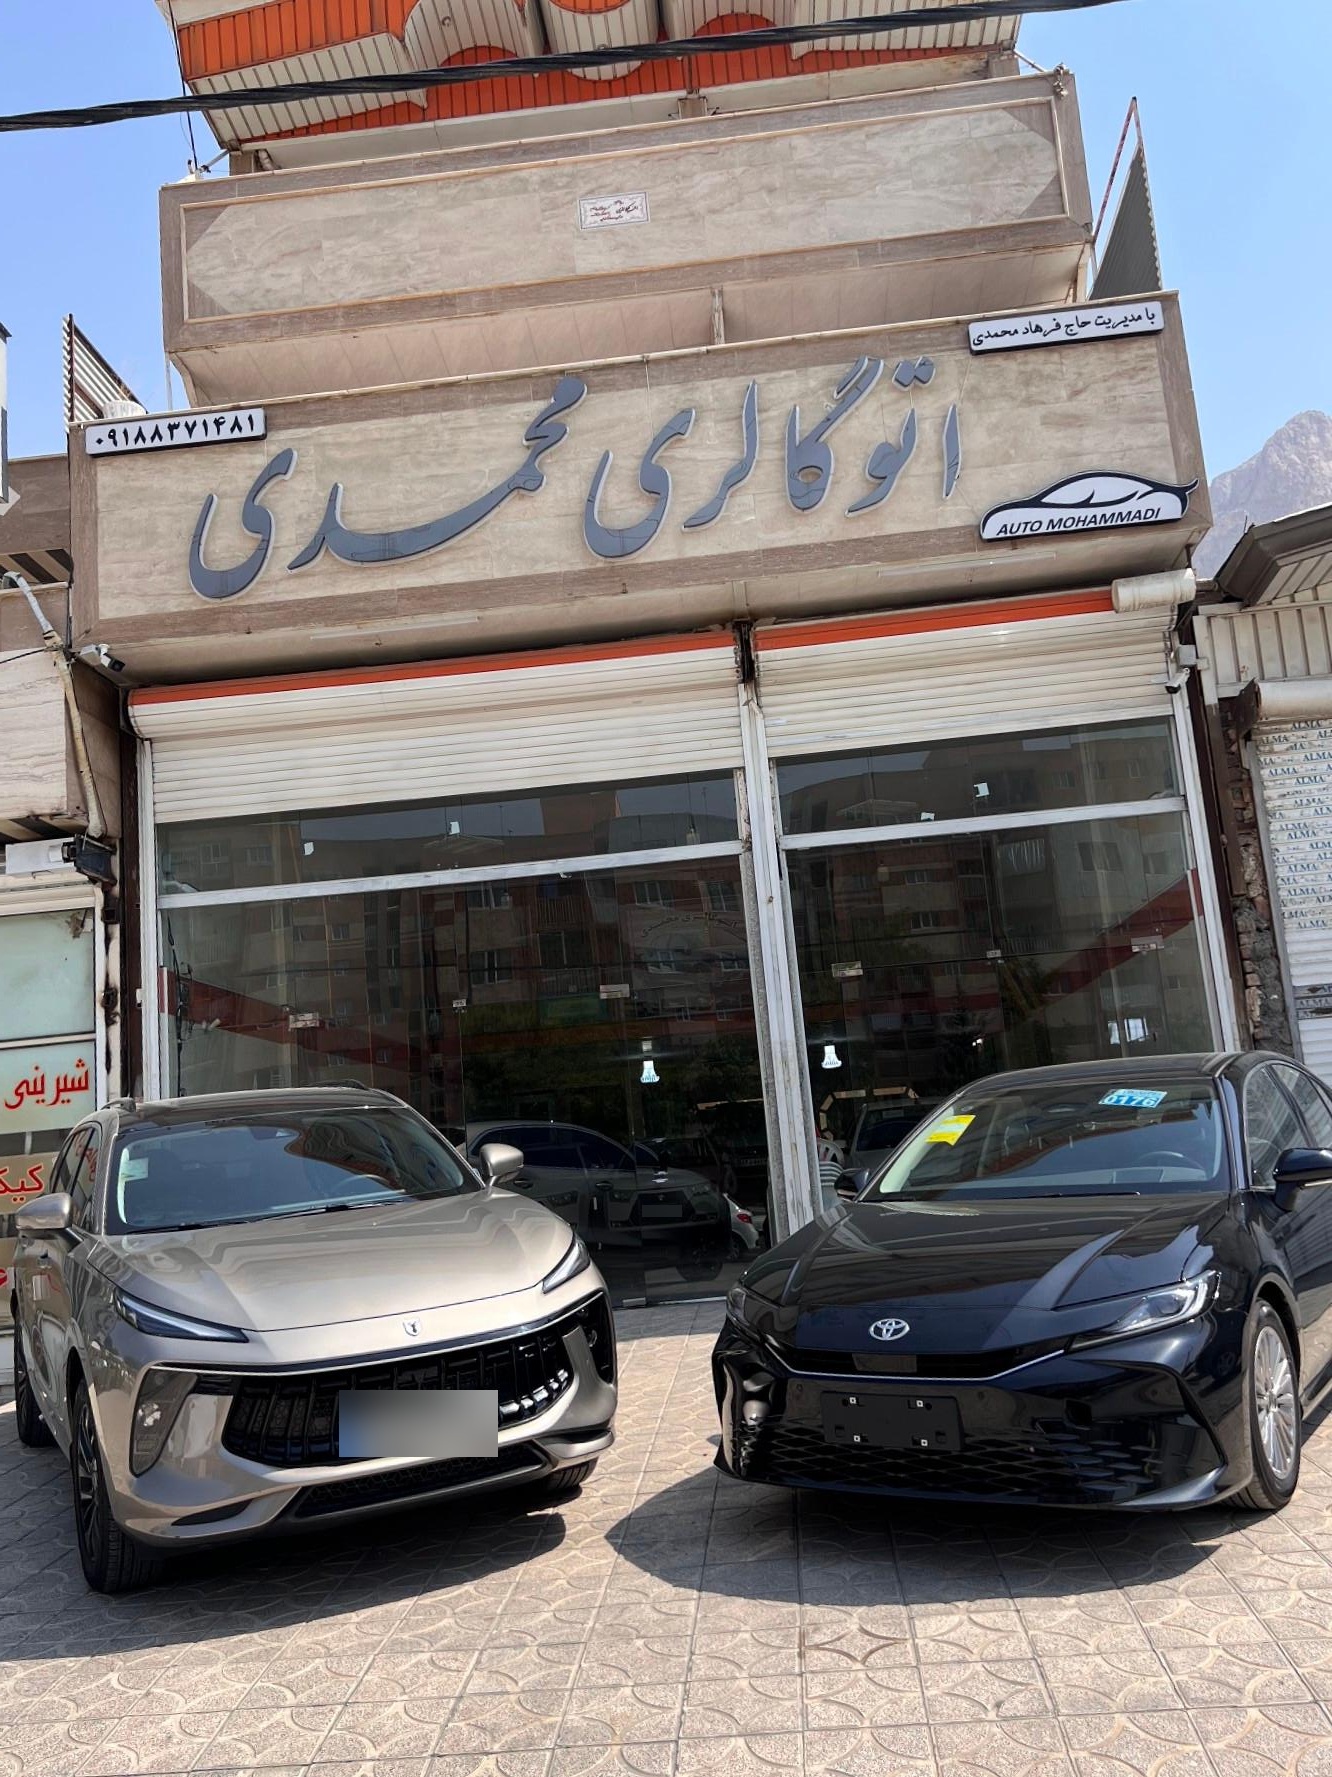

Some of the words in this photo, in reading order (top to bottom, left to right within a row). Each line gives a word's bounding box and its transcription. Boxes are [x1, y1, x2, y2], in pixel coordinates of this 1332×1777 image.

[1064, 315, 1091, 336] حاج
[1094, 313, 1143, 329] مدیریت
[1144, 307, 1156, 325] با
[972, 328, 1019, 346] محمدی
[1022, 318, 1062, 337] فرهاد
[95, 413, 255, 448] ۰۹۱۸۸۳۷۱۴۸۱
[187, 377, 588, 600] محمدی
[996, 520, 1043, 536] AUTO
[1045, 507, 1162, 531] MOHAMMADI
[4, 1058, 91, 1111] شیرینی
